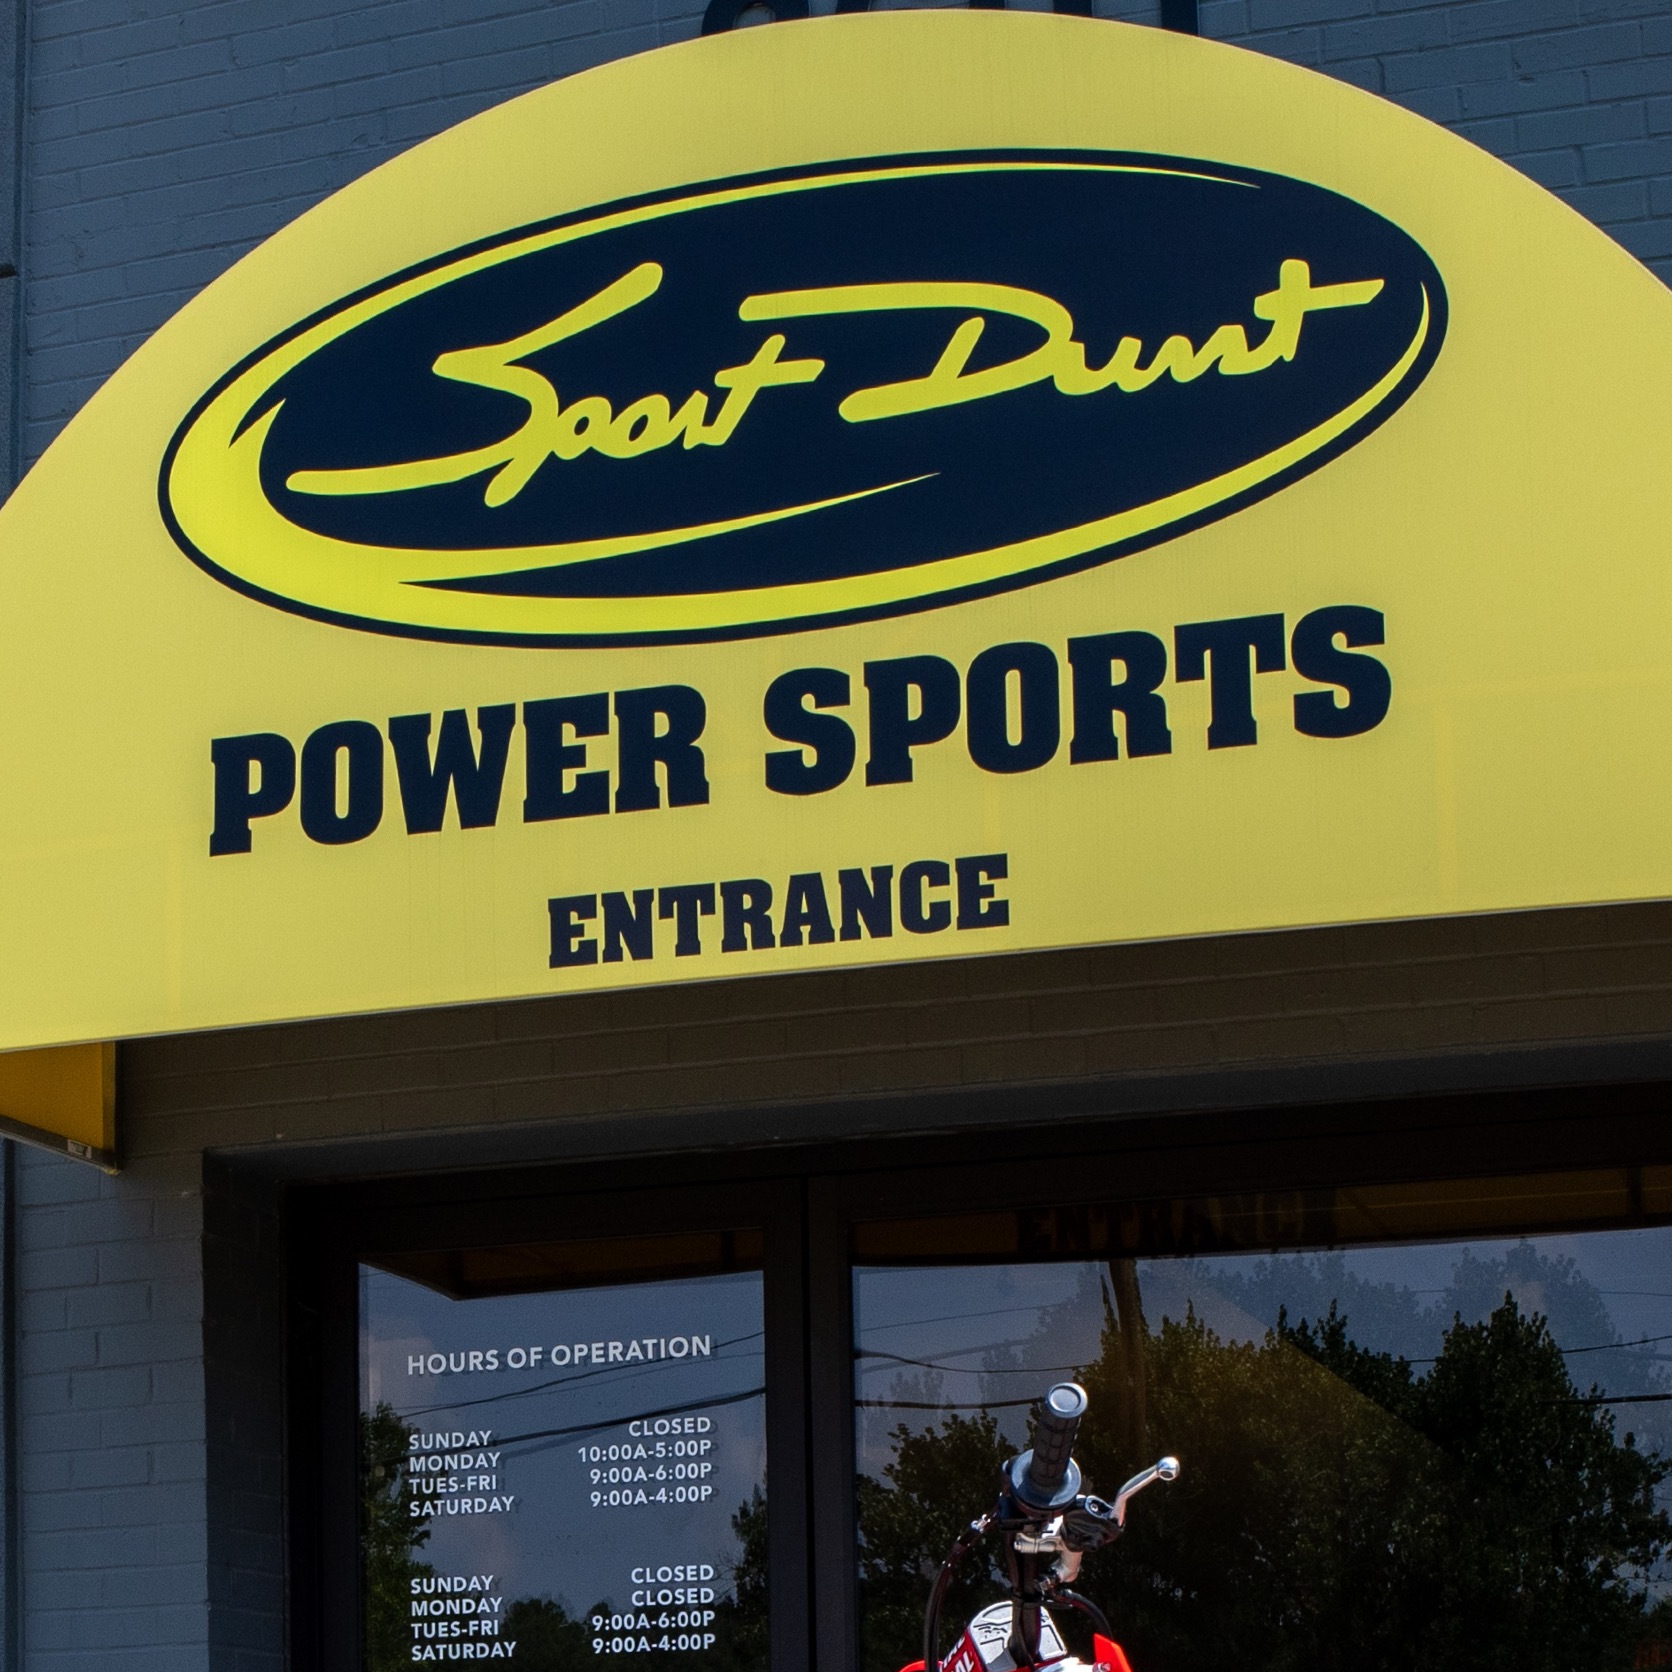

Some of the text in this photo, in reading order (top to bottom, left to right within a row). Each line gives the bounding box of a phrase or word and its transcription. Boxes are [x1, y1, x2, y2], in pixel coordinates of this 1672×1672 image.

[287, 261, 825, 507] Sport
[210, 604, 1393, 858] POWER SPORTS
[548, 854, 1012, 970] ENTRANCE
[408, 1335, 712, 1375] HOURS OF OPERATION
[409, 1417, 712, 1450] SUNDAY CLOSED
[410, 1440, 713, 1472] MONDAY 10:00A-5:00P
[410, 1463, 713, 1494] TUES-FRI 9:00A-6:00P
[410, 1486, 714, 1517] SATURDAY 9:00A-4:00P
[411, 1565, 715, 1594] SUNDAY CLOSED
[411, 1588, 715, 1617] MONDAY CLOSED
[411, 1611, 716, 1639] TUES-FRI 9:00A-6:00P
[411, 1634, 716, 1661] SATURDAY 9:00A-4:00P
